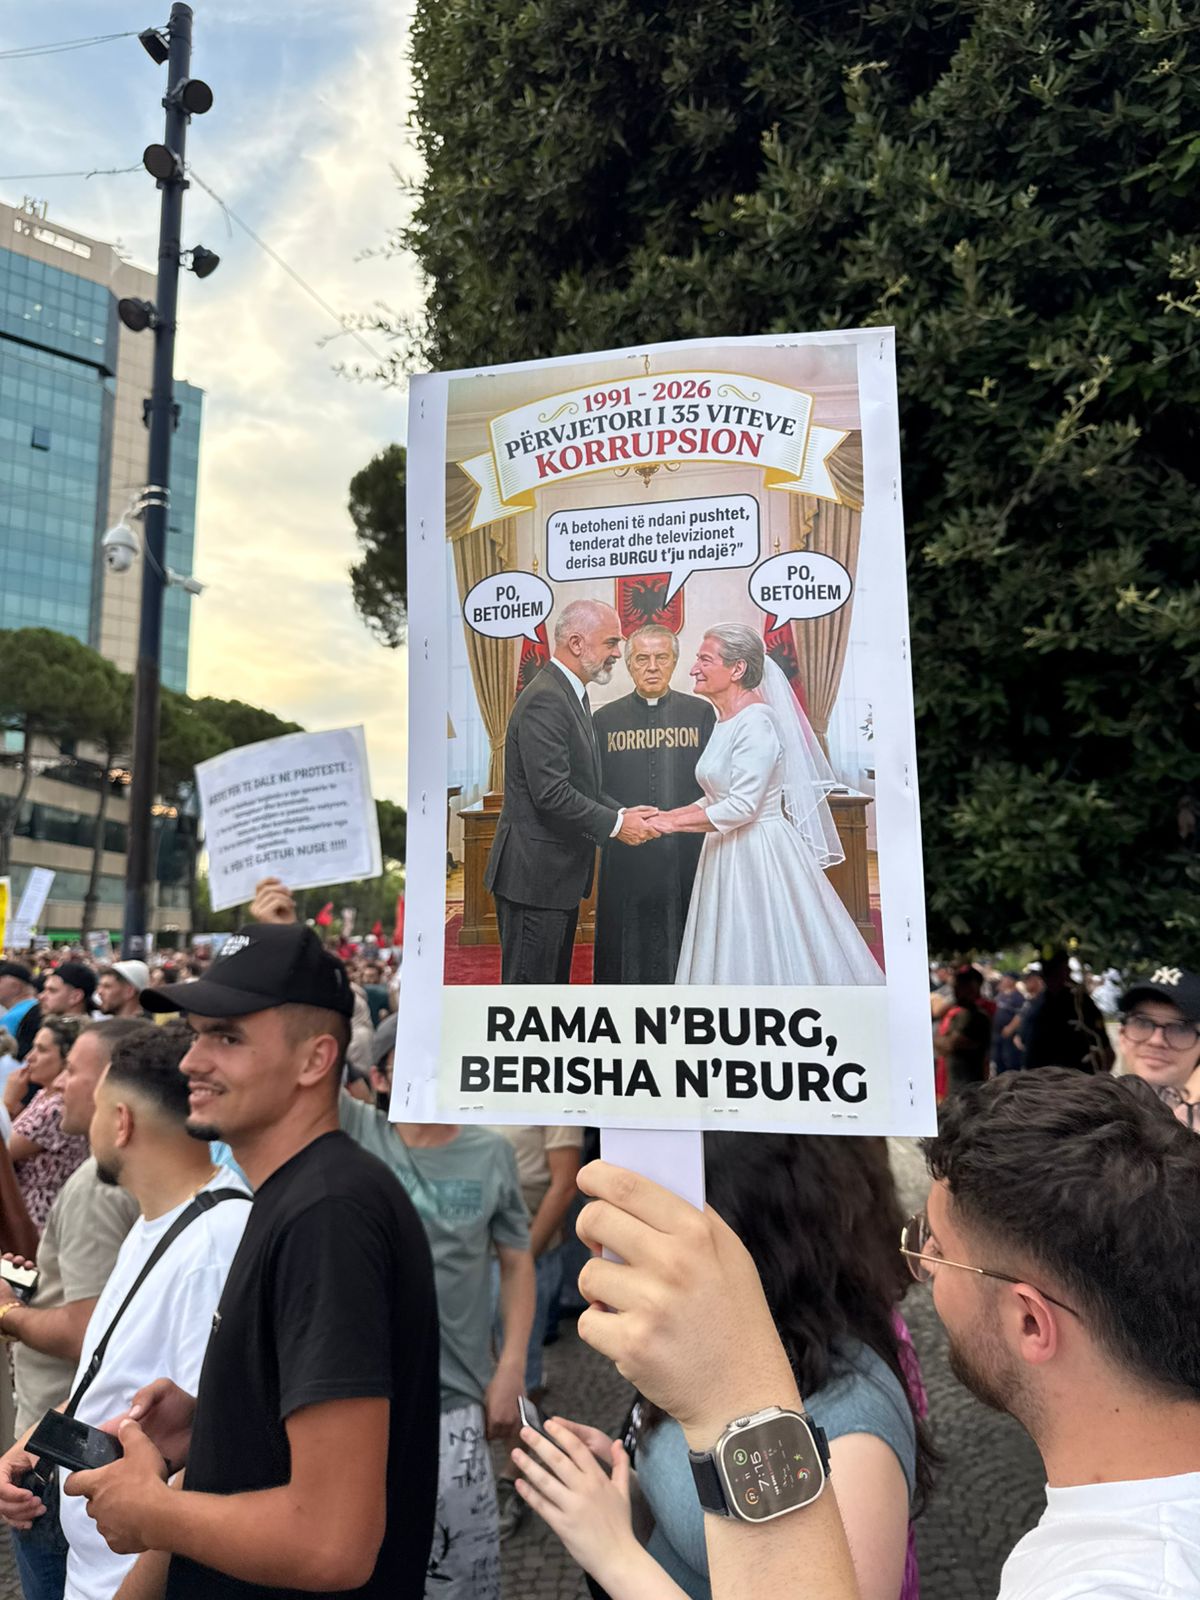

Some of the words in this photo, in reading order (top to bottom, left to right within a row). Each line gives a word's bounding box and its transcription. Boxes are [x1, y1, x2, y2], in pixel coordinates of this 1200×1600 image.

[583, 386, 632, 413] 1991
[652, 379, 712, 402] 2026
[504, 407, 652, 460] PËRVJETORI
[657, 405, 666, 425] I
[671, 403, 700, 424] 35
[706, 403, 797, 437] VITEVE
[534, 427, 765, 479] KORRUPSION
[571, 515, 629, 534] betoheni
[631, 514, 645, 529] të
[648, 511, 686, 528] ndani
[689, 506, 750, 527] pushtet,
[569, 536, 625, 552] tenderat
[628, 532, 653, 547] dhe
[656, 525, 735, 545] televizionet
[565, 554, 606, 570] derisa
[609, 549, 658, 567] BURGU
[786, 564, 815, 583] PO,
[495, 584, 521, 604] PO,
[760, 584, 842, 602] BETOHEM
[472, 601, 544, 624] BETOHEM
[607, 726, 699, 753] KORRUPSION
[486, 1006, 621, 1044] RAMA
[635, 1005, 838, 1056] N’BURG,
[459, 1055, 661, 1098] BERISHA
[675, 1057, 868, 1103] N’BURG
[750, 1450, 770, 1493] 7:15
